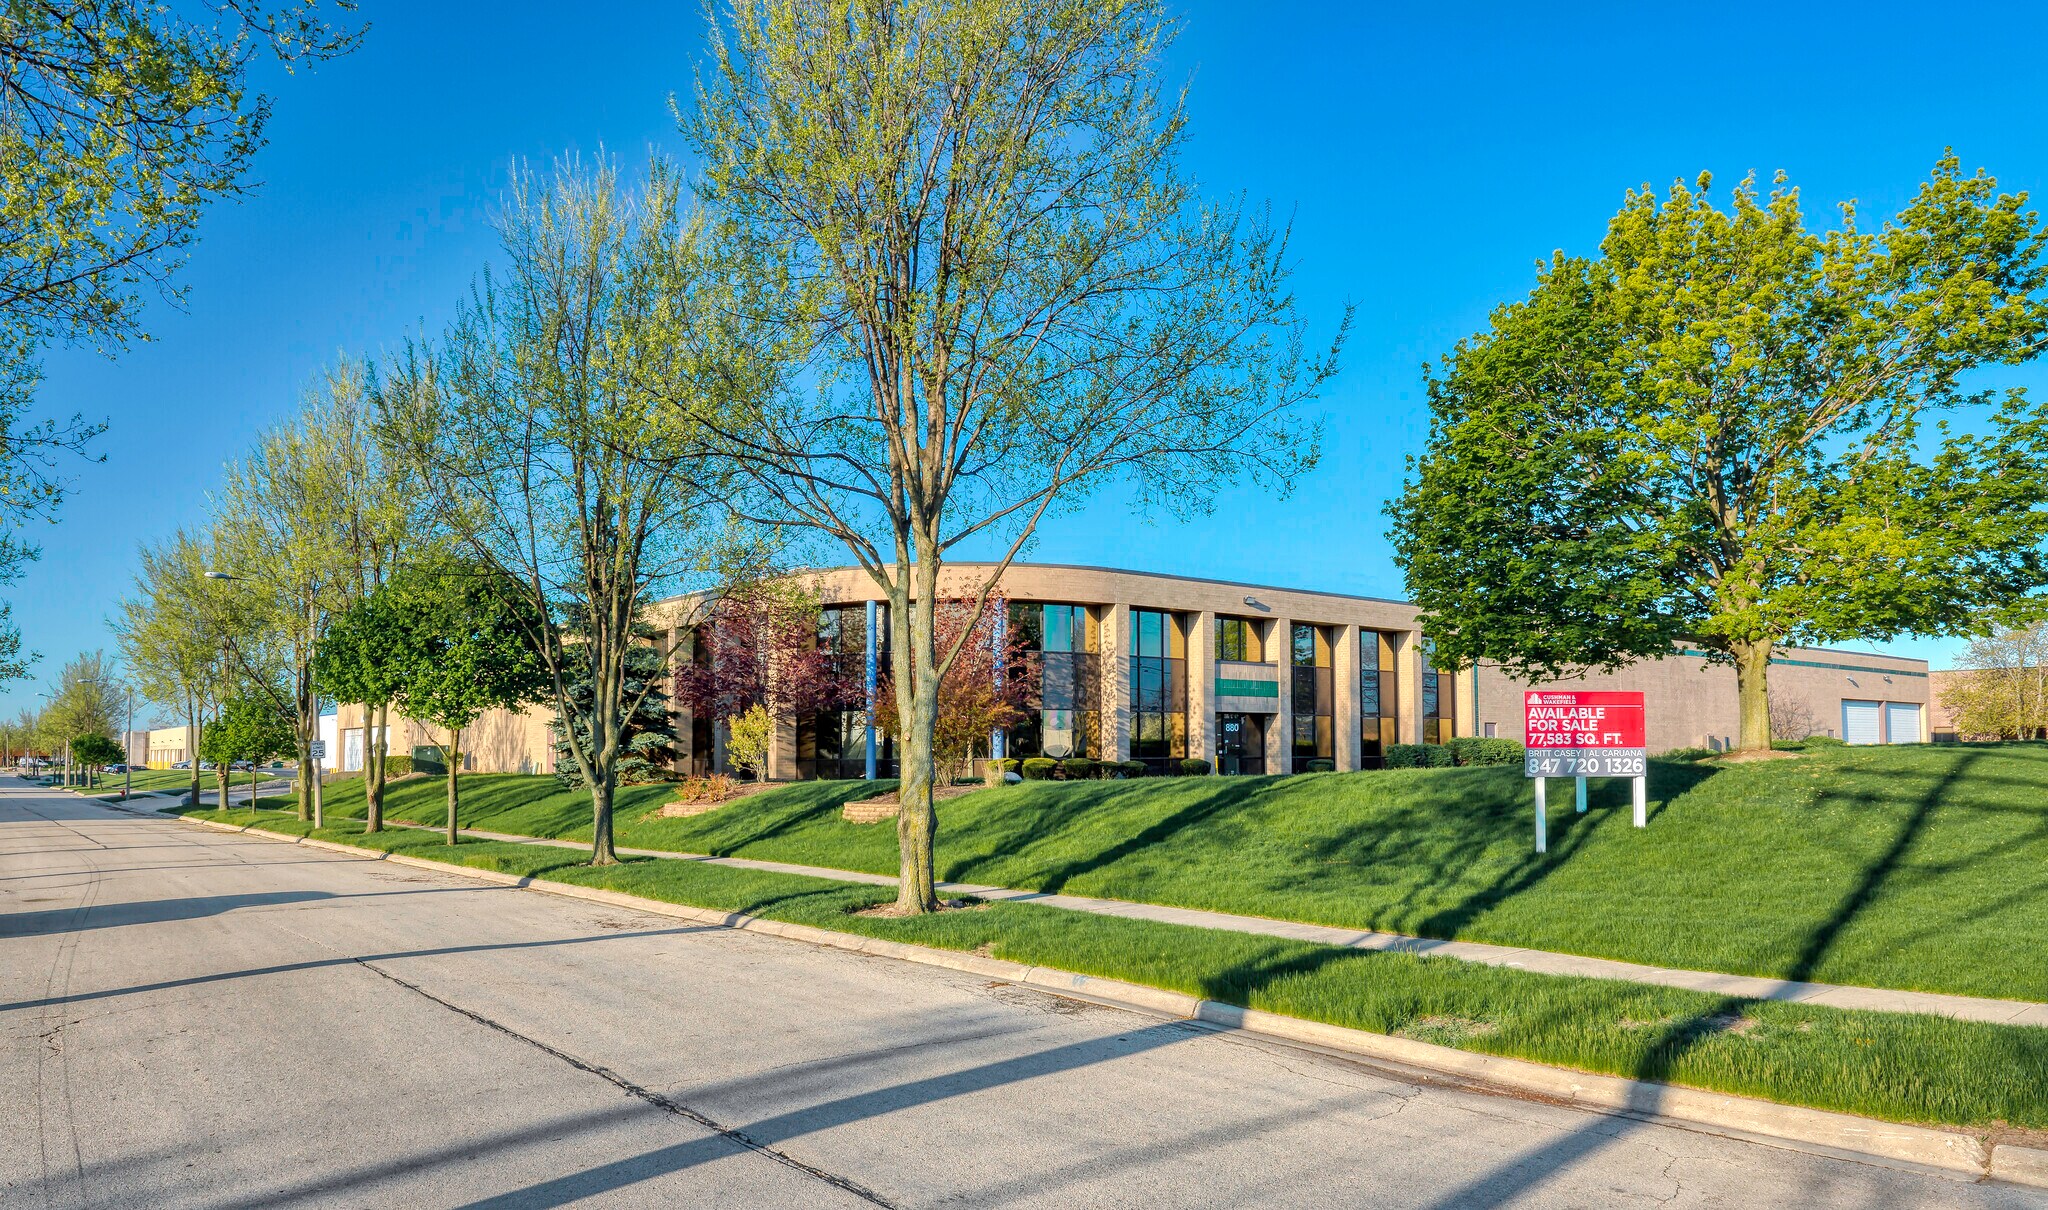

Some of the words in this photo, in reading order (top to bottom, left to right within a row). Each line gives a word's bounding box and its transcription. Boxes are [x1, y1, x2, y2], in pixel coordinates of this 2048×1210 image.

[1528, 708, 1605, 719] AVAILABLE
[1528, 720, 1558, 731] FOR
[1562, 720, 1598, 731] SALE
[1528, 733, 1572, 746] 77,583
[1576, 733, 1599, 744] SQ.
[1604, 733, 1622, 744] FT.
[1528, 758, 1560, 773] 847
[1566, 758, 1599, 773] 720
[1605, 758, 1644, 773] 1326
